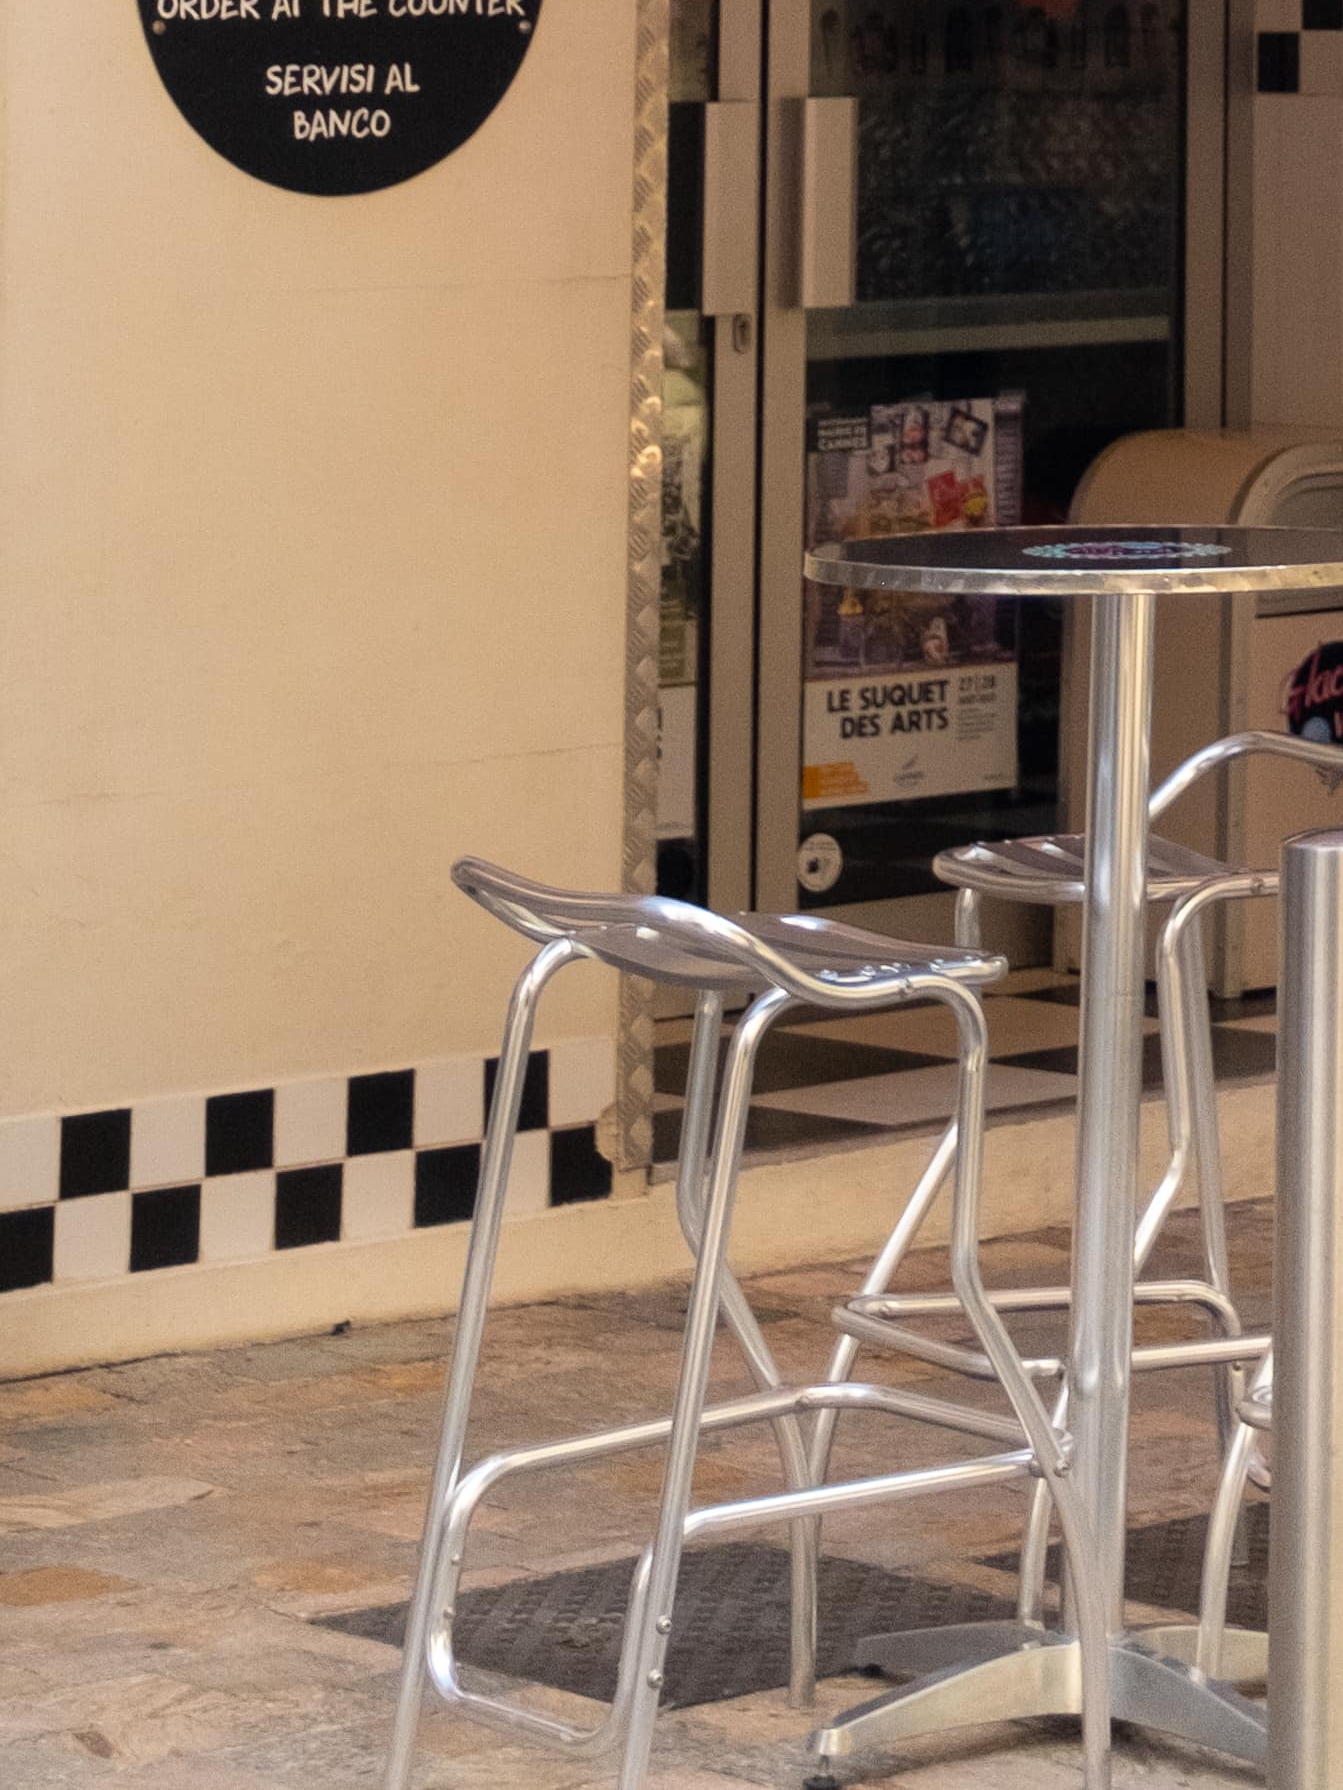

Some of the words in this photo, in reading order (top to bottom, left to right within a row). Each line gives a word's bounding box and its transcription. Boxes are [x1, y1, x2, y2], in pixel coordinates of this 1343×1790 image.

[265, 64, 375, 96] SERVISI
[385, 62, 420, 95] AL
[292, 108, 391, 142] BANCO
[826, 689, 851, 713] LE
[859, 679, 950, 711] SUQUET
[840, 713, 881, 740] DES
[890, 707, 950, 735] ARTS
